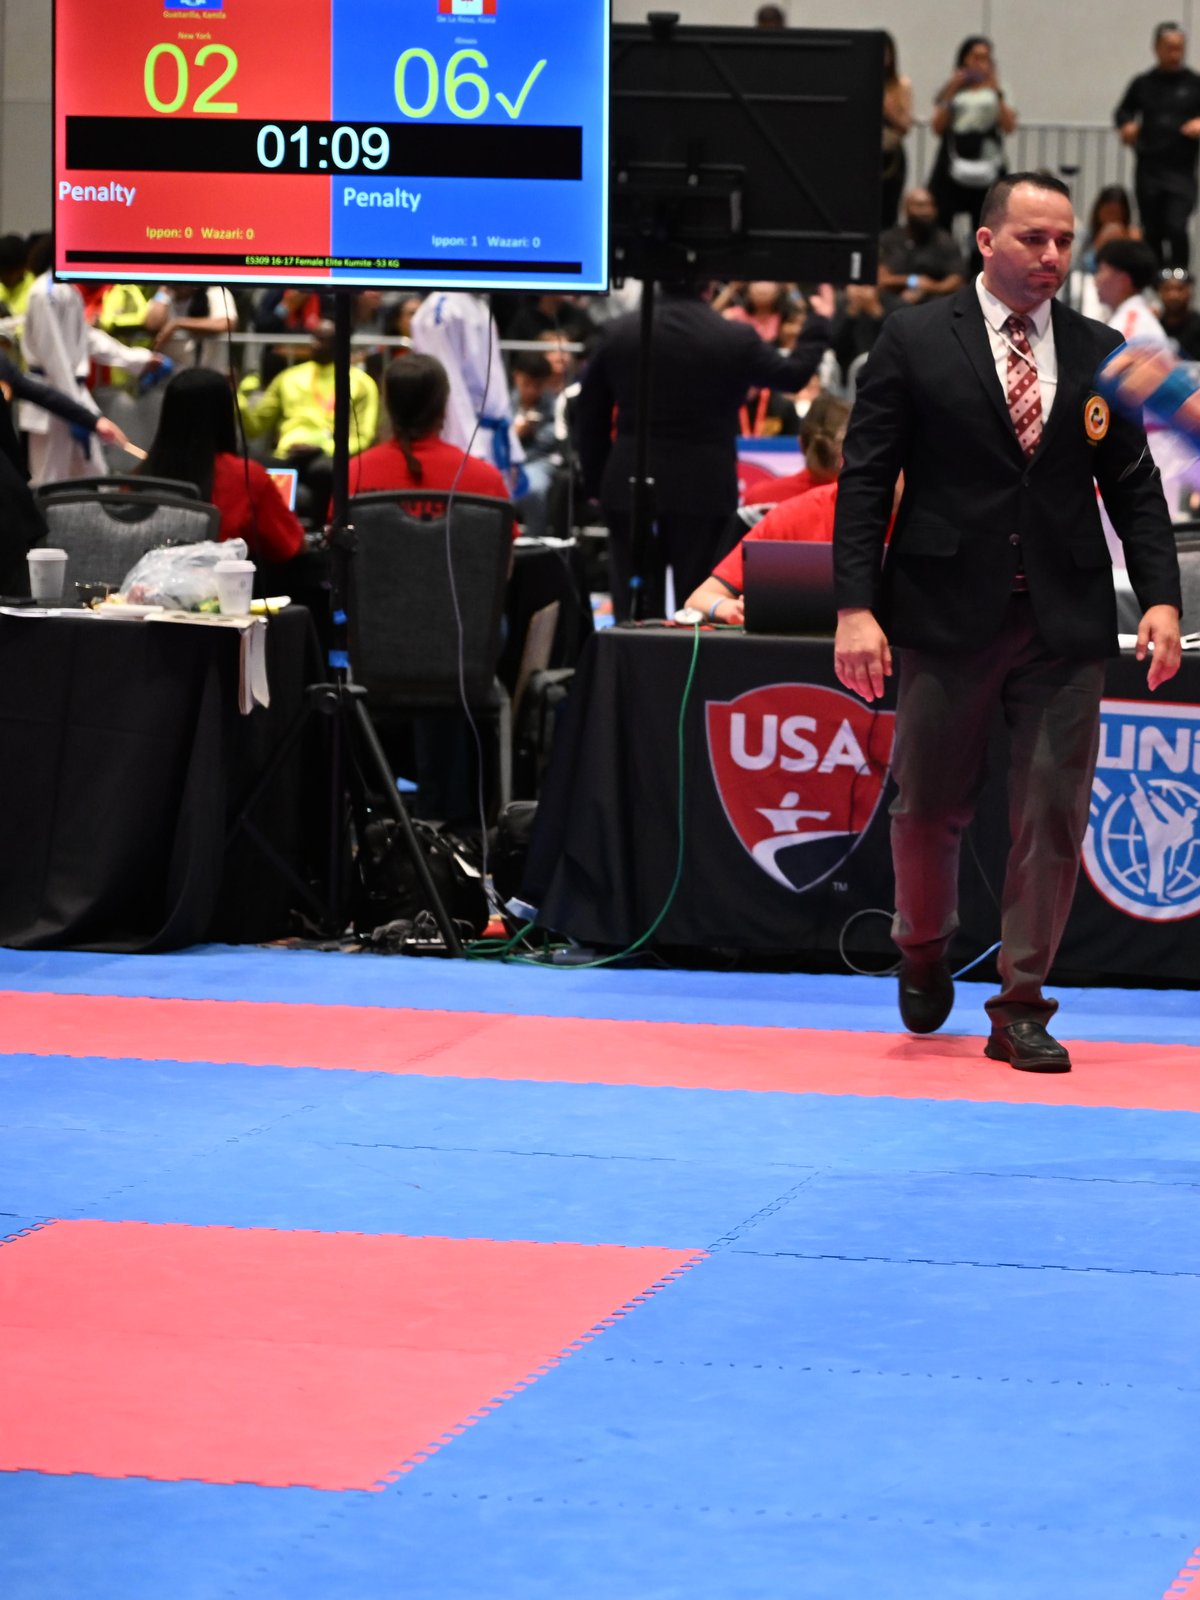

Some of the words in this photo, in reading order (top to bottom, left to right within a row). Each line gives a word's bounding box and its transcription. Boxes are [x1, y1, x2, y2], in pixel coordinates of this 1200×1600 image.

[178, 31, 194, 40] New
[195, 32, 212, 40] York
[144, 43, 239, 114] 02
[394, 48, 489, 119] 06
[256, 125, 390, 170] 01:09
[58, 181, 136, 206] Penalty
[343, 187, 421, 211] Penalty
[146, 226, 182, 240] Ippon:
[184, 226, 193, 239] 0
[201, 227, 243, 240] Wazari:
[246, 228, 255, 240] 0
[432, 235, 467, 248] Ippon:
[471, 235, 478, 247] 1
[487, 236, 530, 248] Wazari:
[532, 236, 541, 248] 0
[271, 256, 294, 266] 16-17
[295, 256, 324, 267] Female
[325, 257, 342, 267] Elite
[344, 258, 372, 268] Kumite
[388, 258, 400, 269] KG
[730, 712, 871, 776] USA
[832, 881, 848, 892] TM
